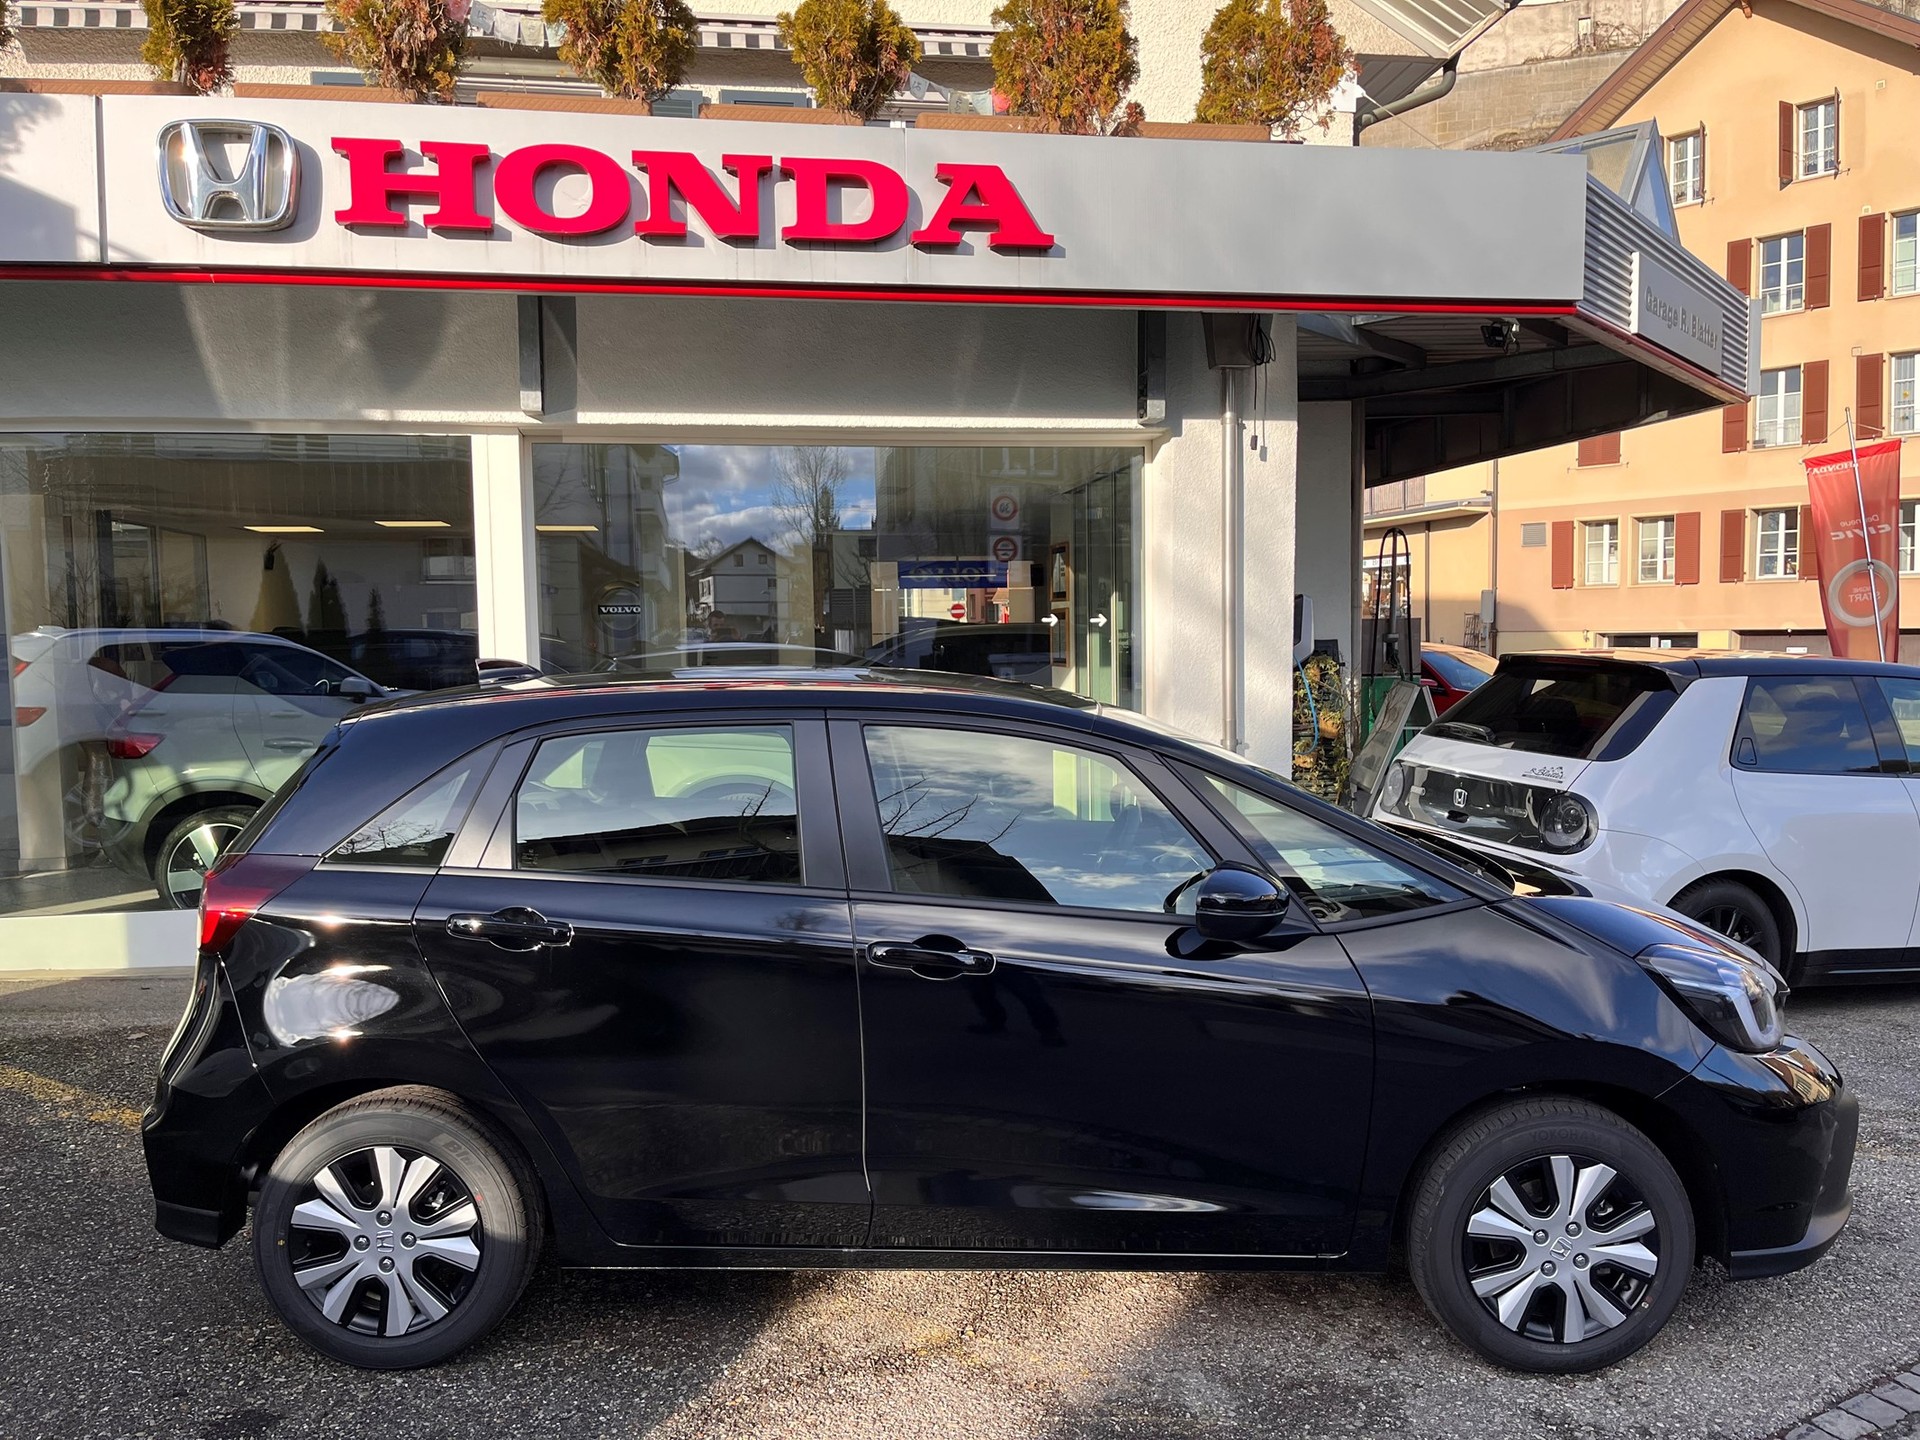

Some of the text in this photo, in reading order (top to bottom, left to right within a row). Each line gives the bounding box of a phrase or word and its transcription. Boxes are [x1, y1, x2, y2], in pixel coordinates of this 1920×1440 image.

[331, 136, 1055, 251] HONDA
[1645, 286, 1678, 329] Garage
[1691, 313, 1717, 350] Blatter
